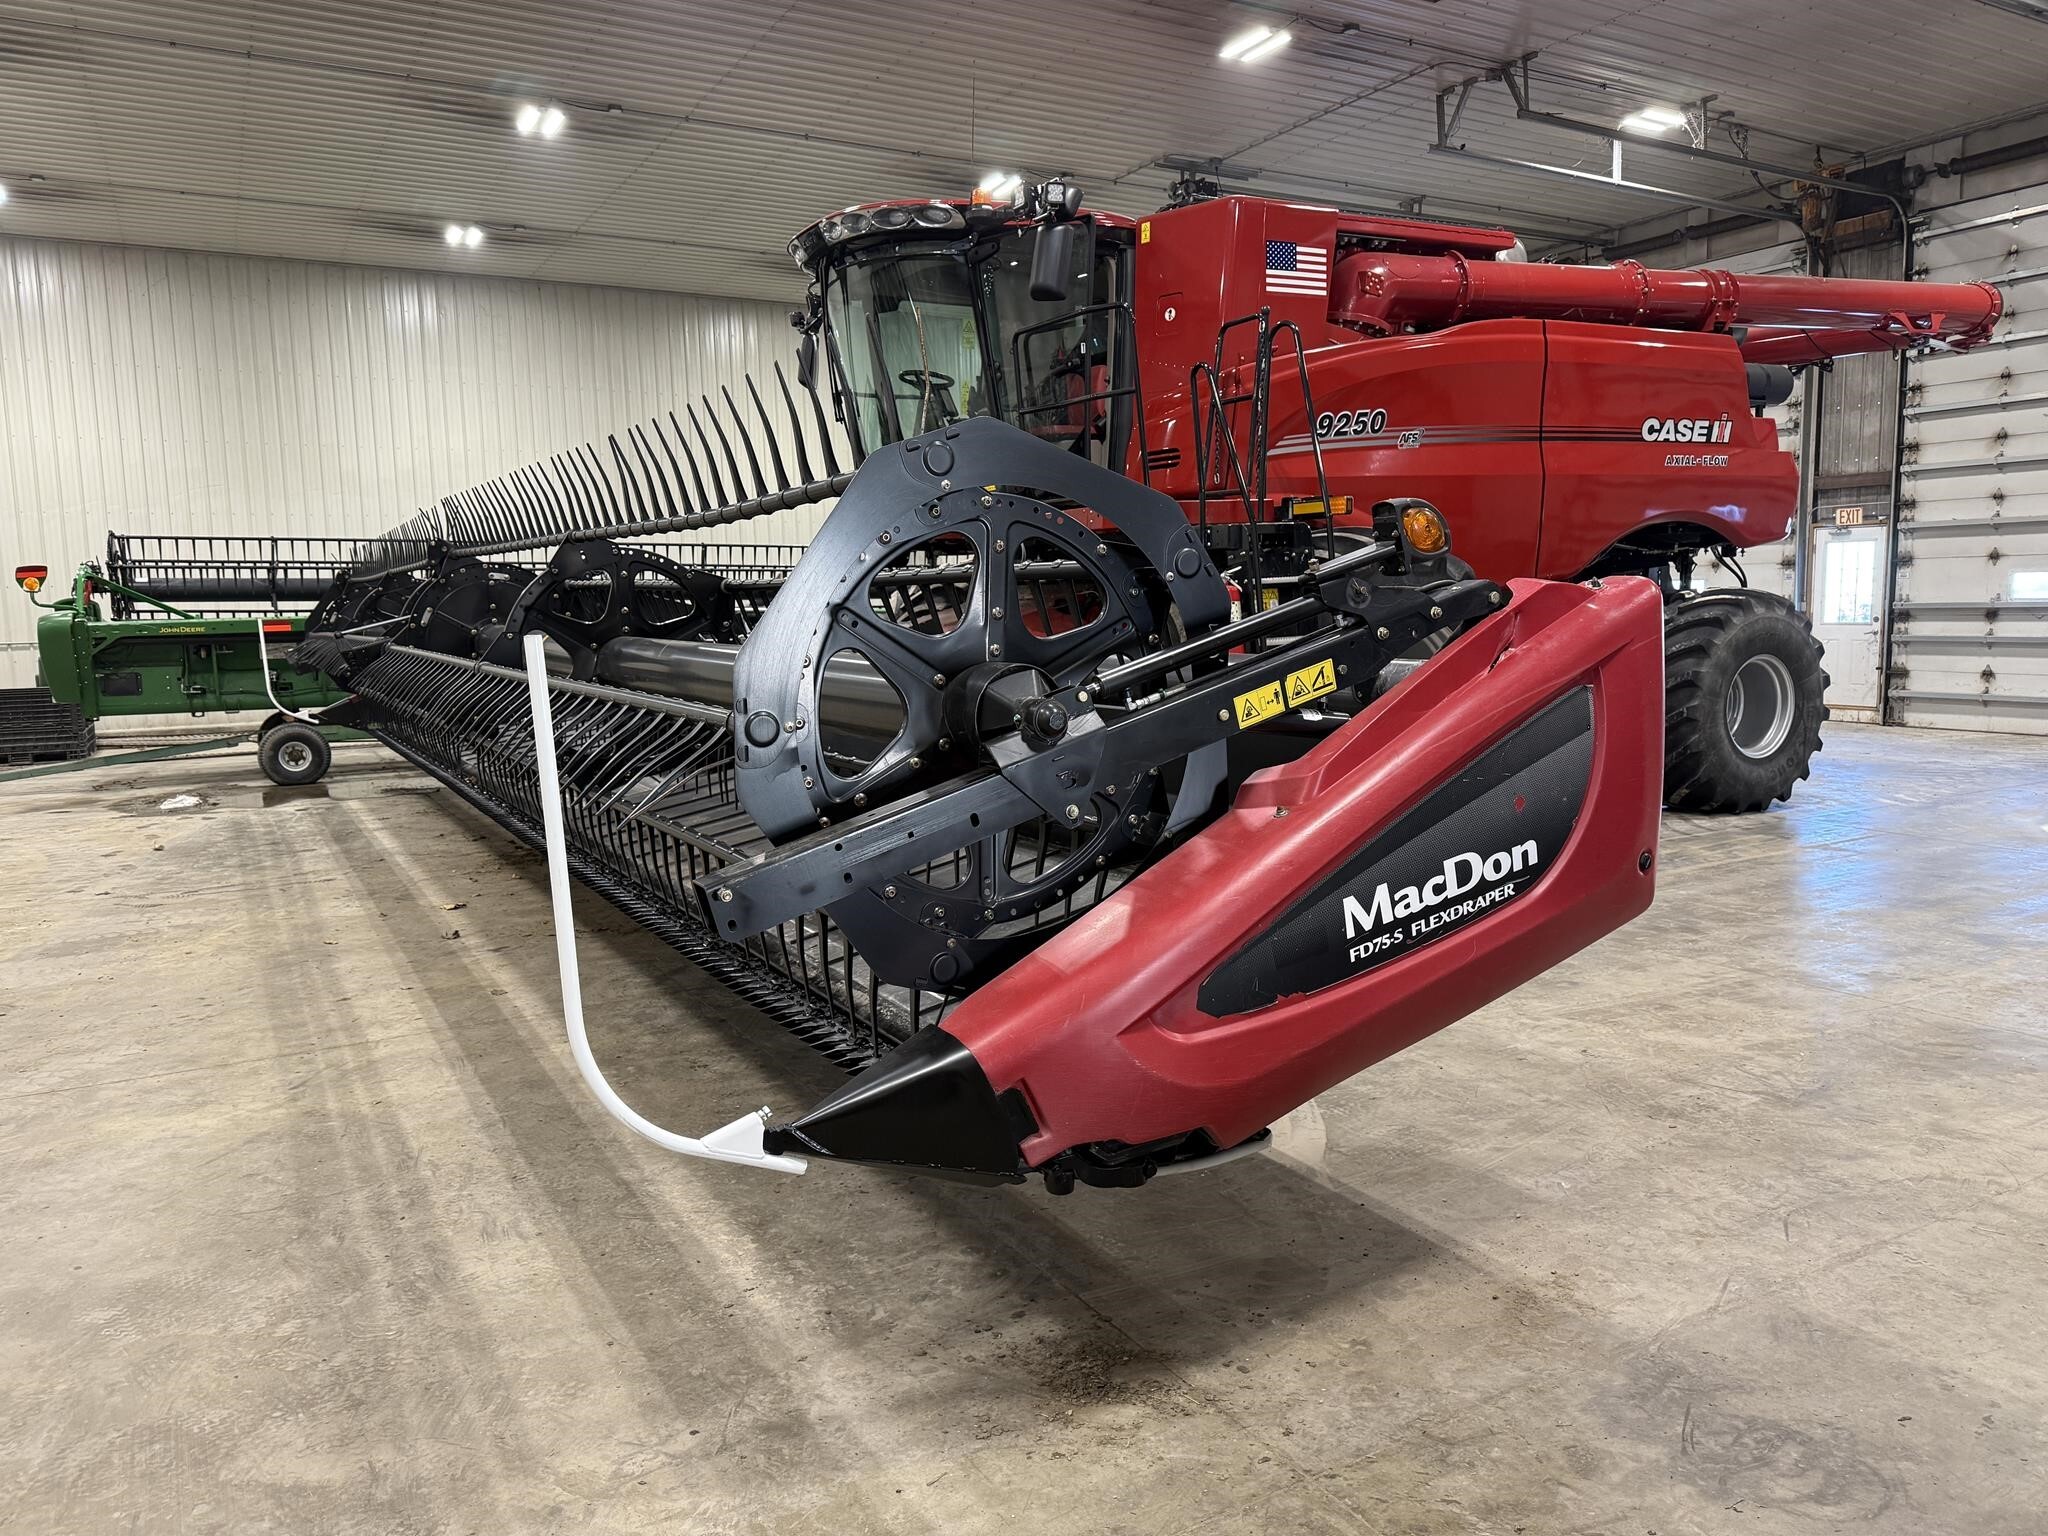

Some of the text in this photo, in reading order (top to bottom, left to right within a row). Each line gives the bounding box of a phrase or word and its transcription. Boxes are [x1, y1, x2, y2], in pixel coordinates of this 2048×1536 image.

[1316, 408, 1387, 439] 9250
[1399, 430, 1421, 444] AFS
[1641, 416, 1710, 443] CASE
[1664, 454, 1729, 467] AXIAL-FLOW
[1839, 509, 1861, 524] EXIT
[1342, 839, 1539, 940] MacDon
[1349, 882, 1516, 964] FD75-S FLEXDRAPER
